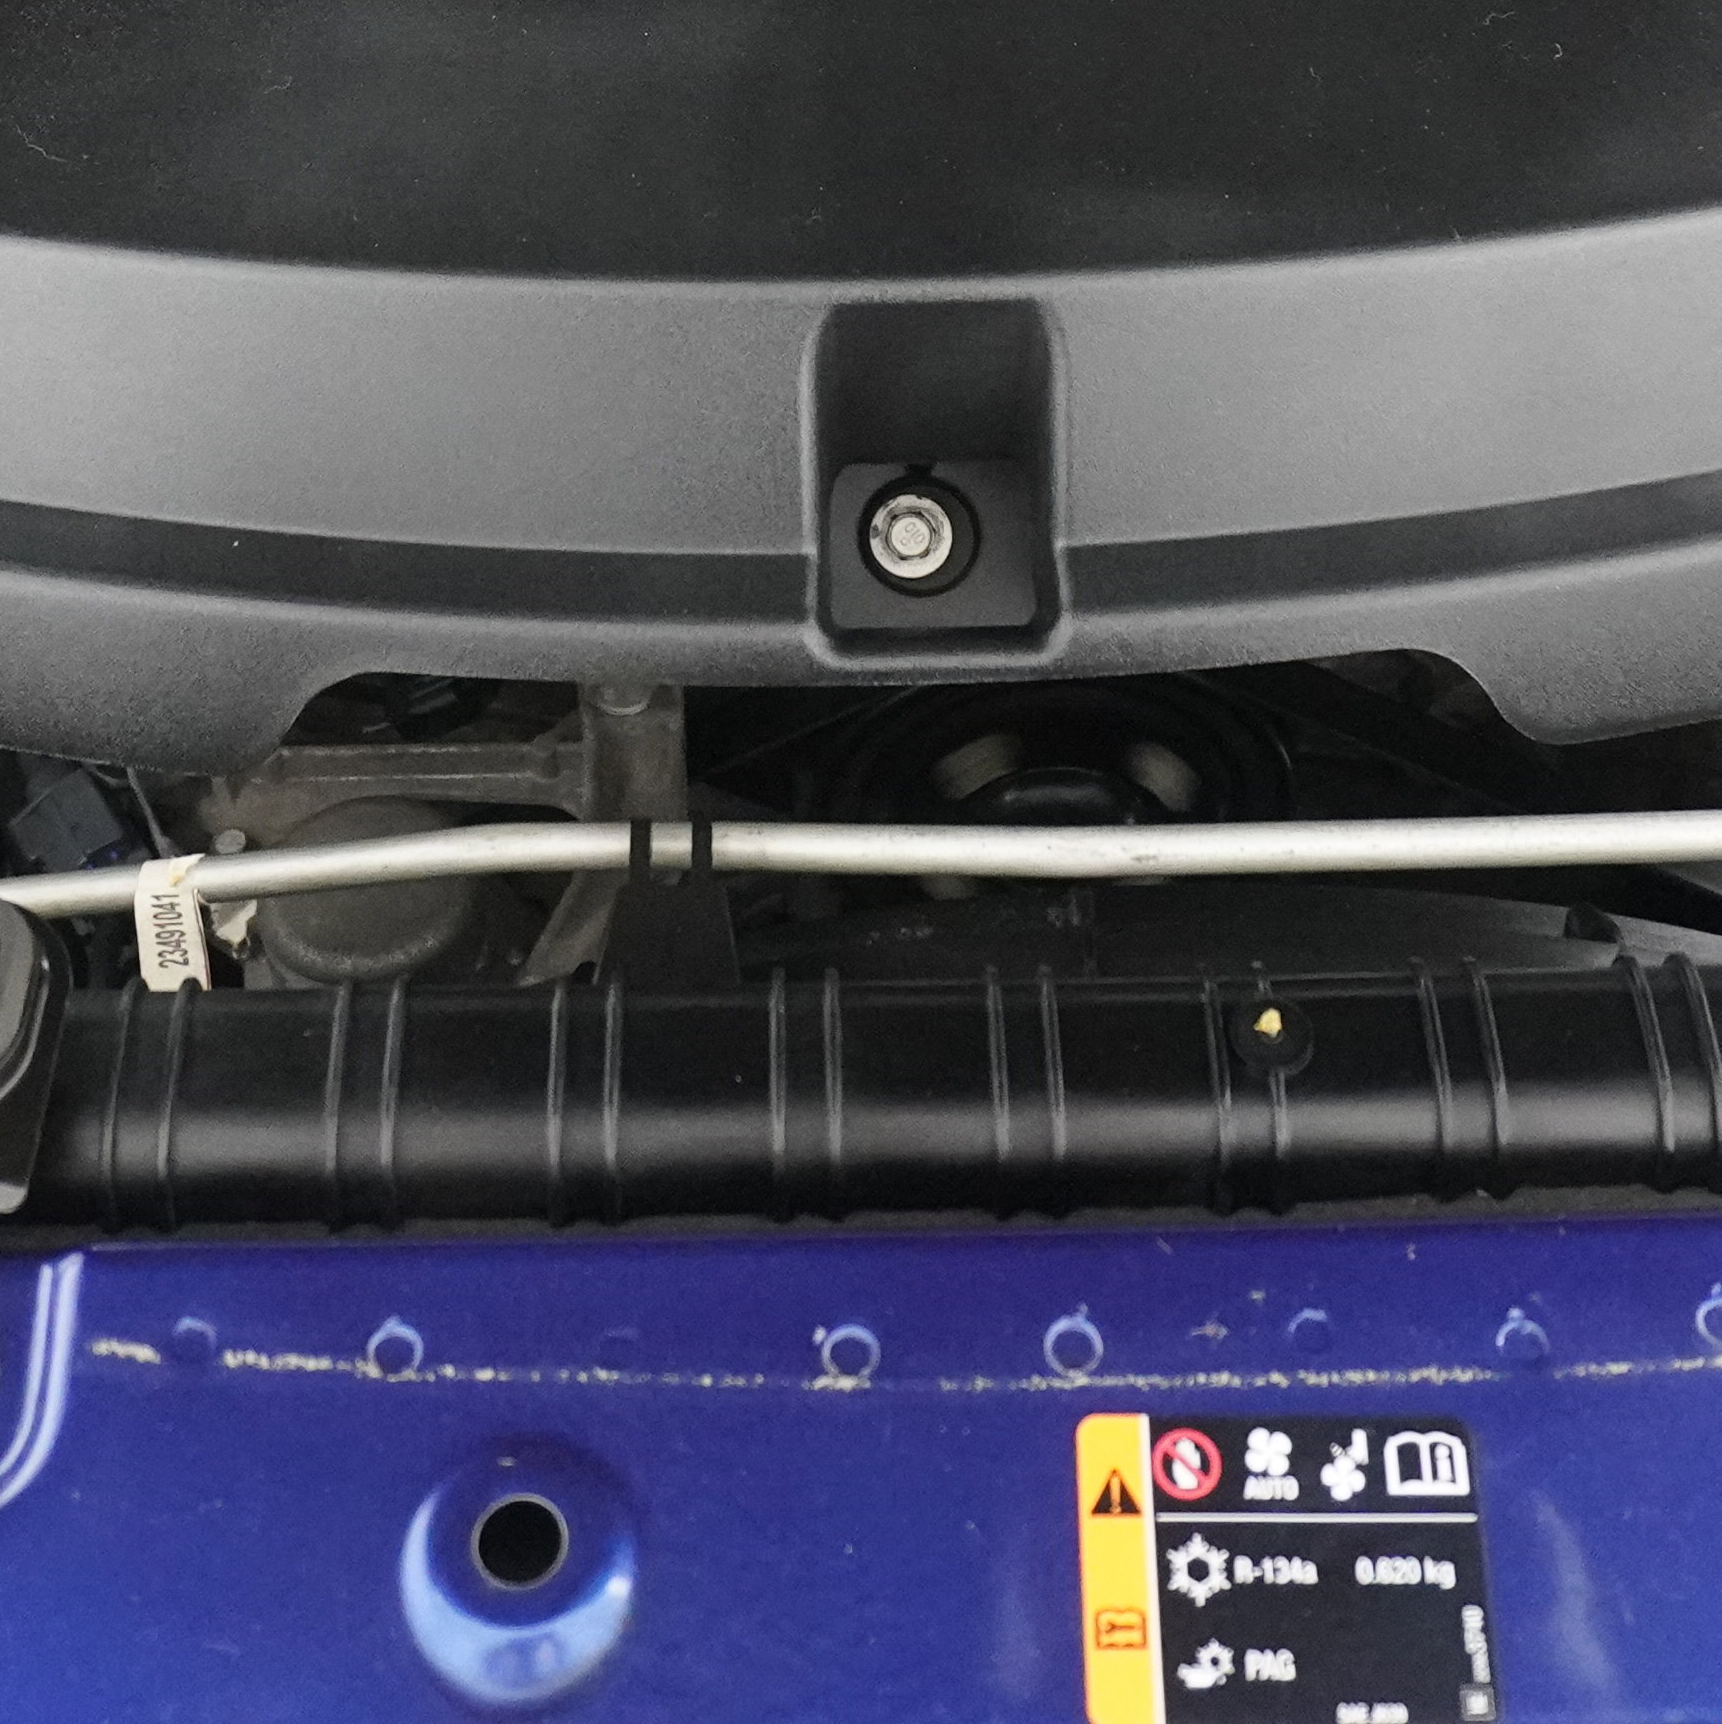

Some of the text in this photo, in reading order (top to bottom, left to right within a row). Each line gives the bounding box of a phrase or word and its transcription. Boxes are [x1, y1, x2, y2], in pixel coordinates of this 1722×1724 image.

[150, 893, 190, 969] 23491041
[1243, 1475, 1299, 1501] AUTO
[1233, 1554, 1319, 1585] R-134a
[1423, 1555, 1457, 1590] kg
[1243, 1647, 1297, 1682] PAG
